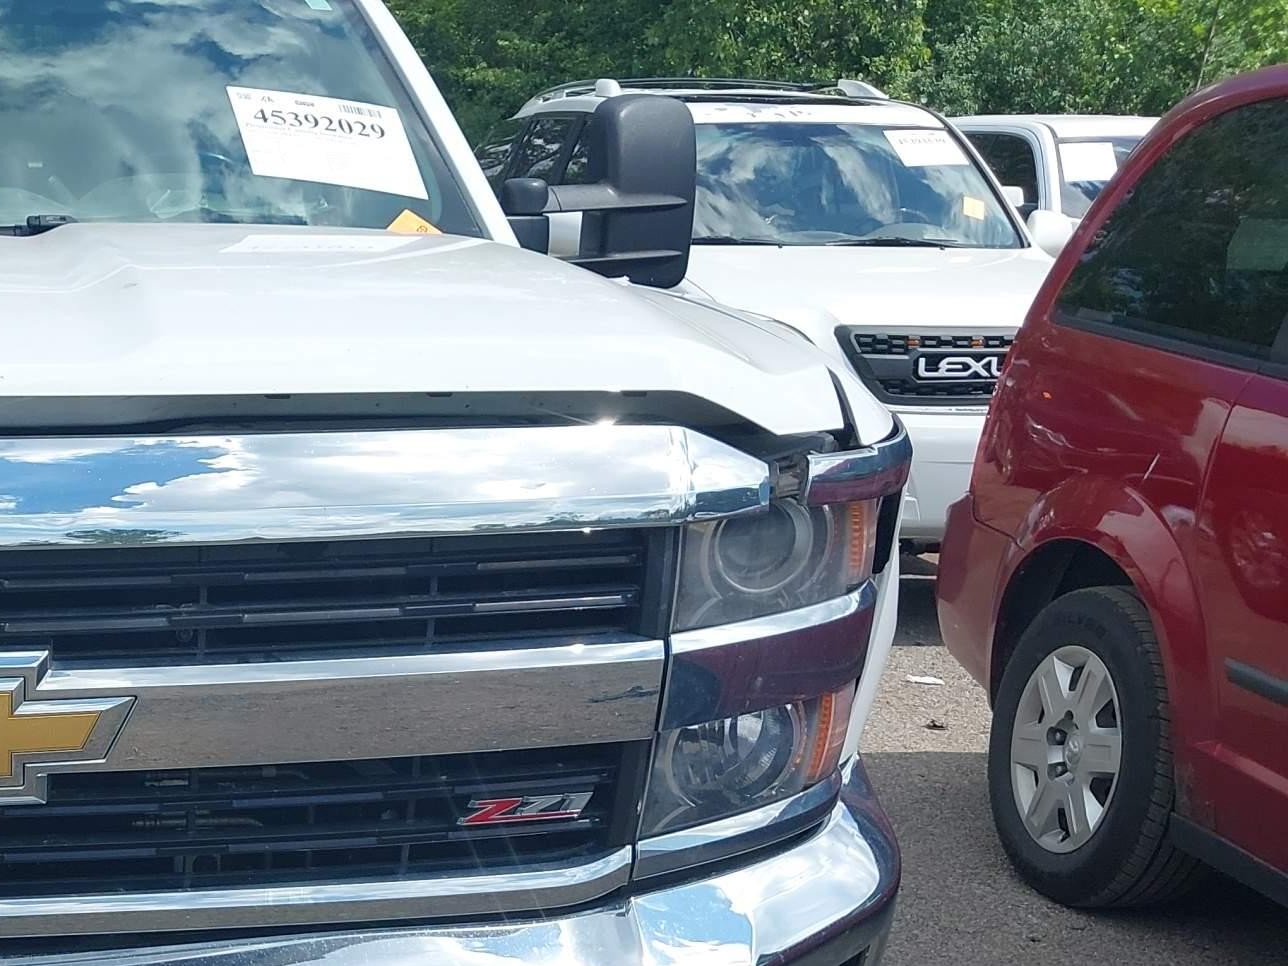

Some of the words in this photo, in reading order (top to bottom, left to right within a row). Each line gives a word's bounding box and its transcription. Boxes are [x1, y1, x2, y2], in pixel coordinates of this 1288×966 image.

[254, 108, 386, 140] 45392029
[918, 356, 1002, 377] LEX
[456, 791, 594, 826] Z71
